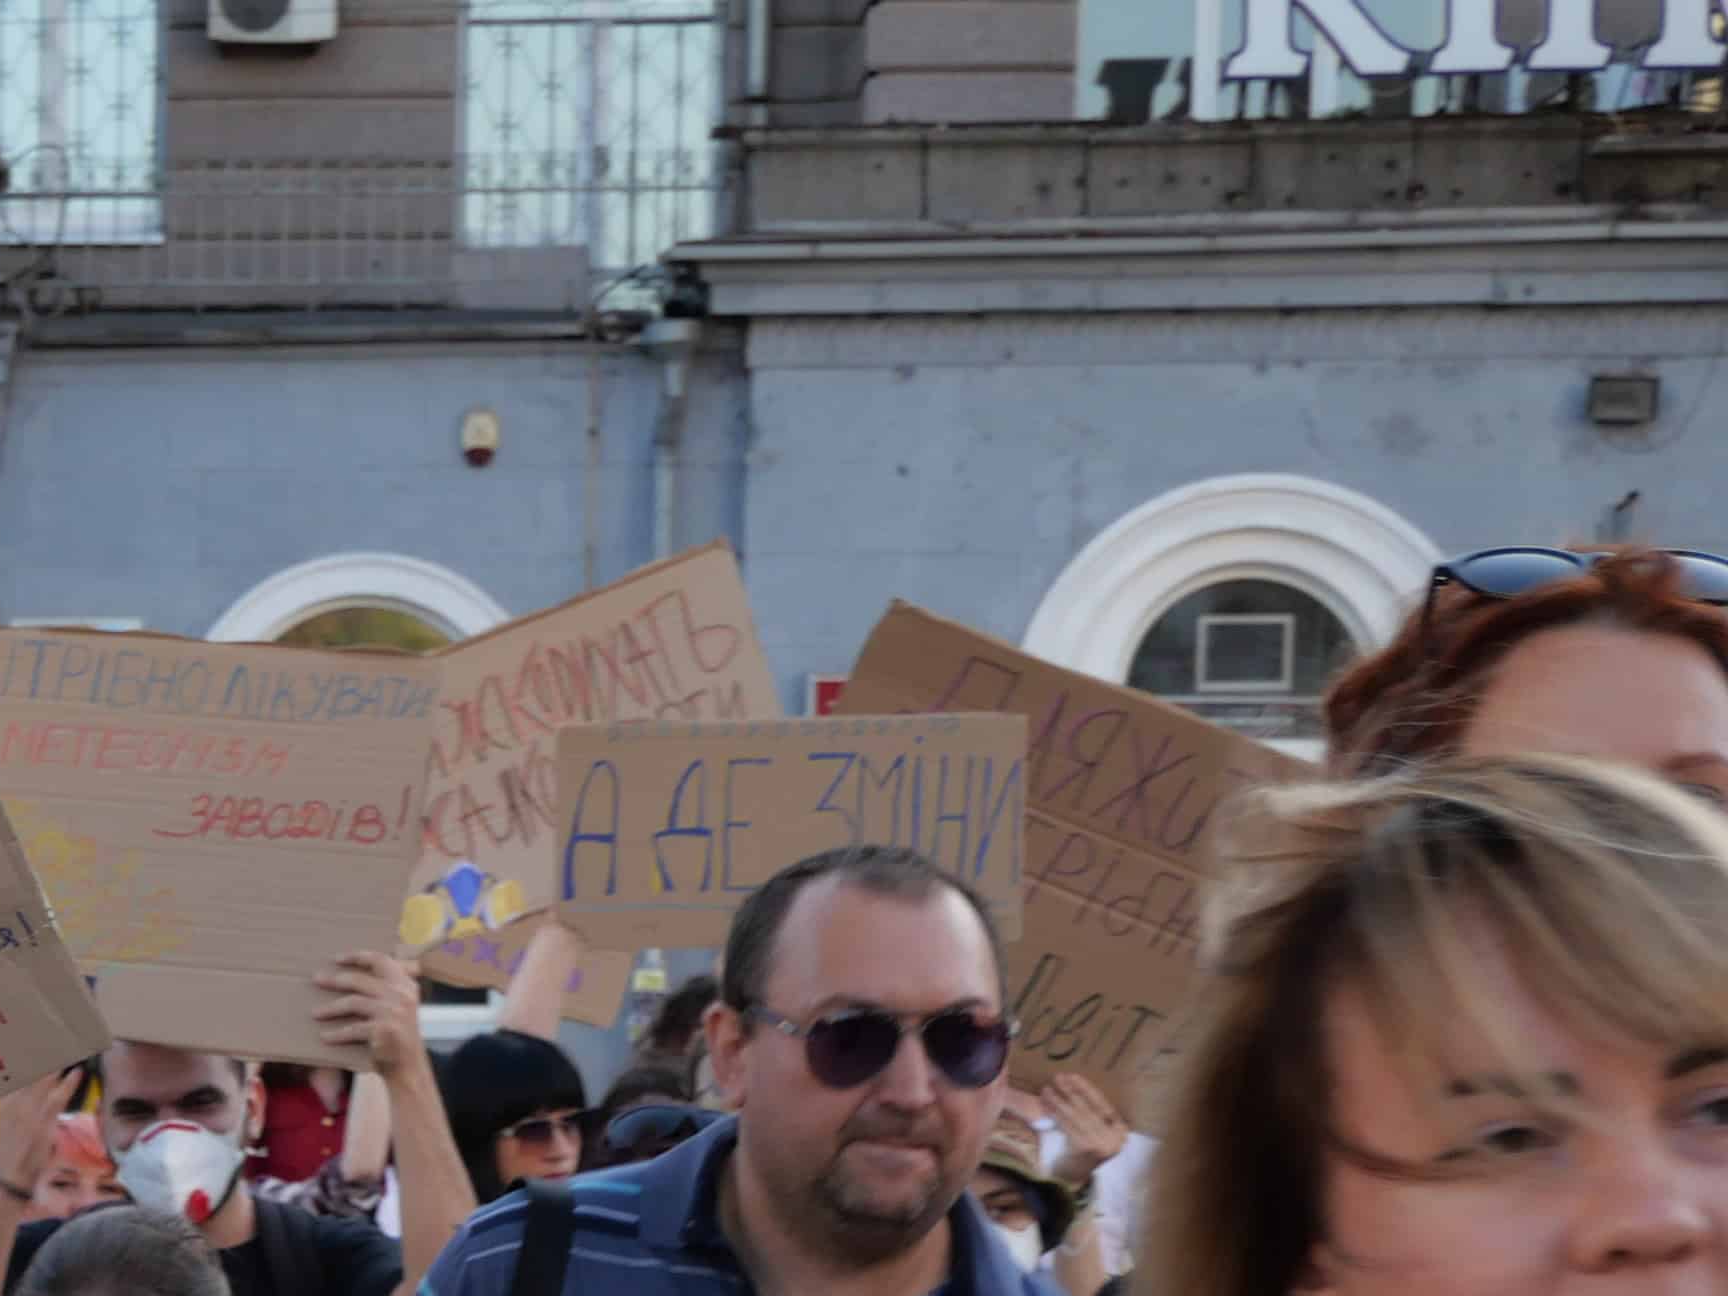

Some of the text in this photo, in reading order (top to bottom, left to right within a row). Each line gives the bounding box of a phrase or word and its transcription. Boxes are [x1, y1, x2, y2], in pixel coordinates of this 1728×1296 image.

[153, 784, 412, 845] ЗАВОДІВ!
[562, 735, 1026, 902] А ДЕ ЗМІНИ
[1091, 733, 1254, 856] ЖИ
